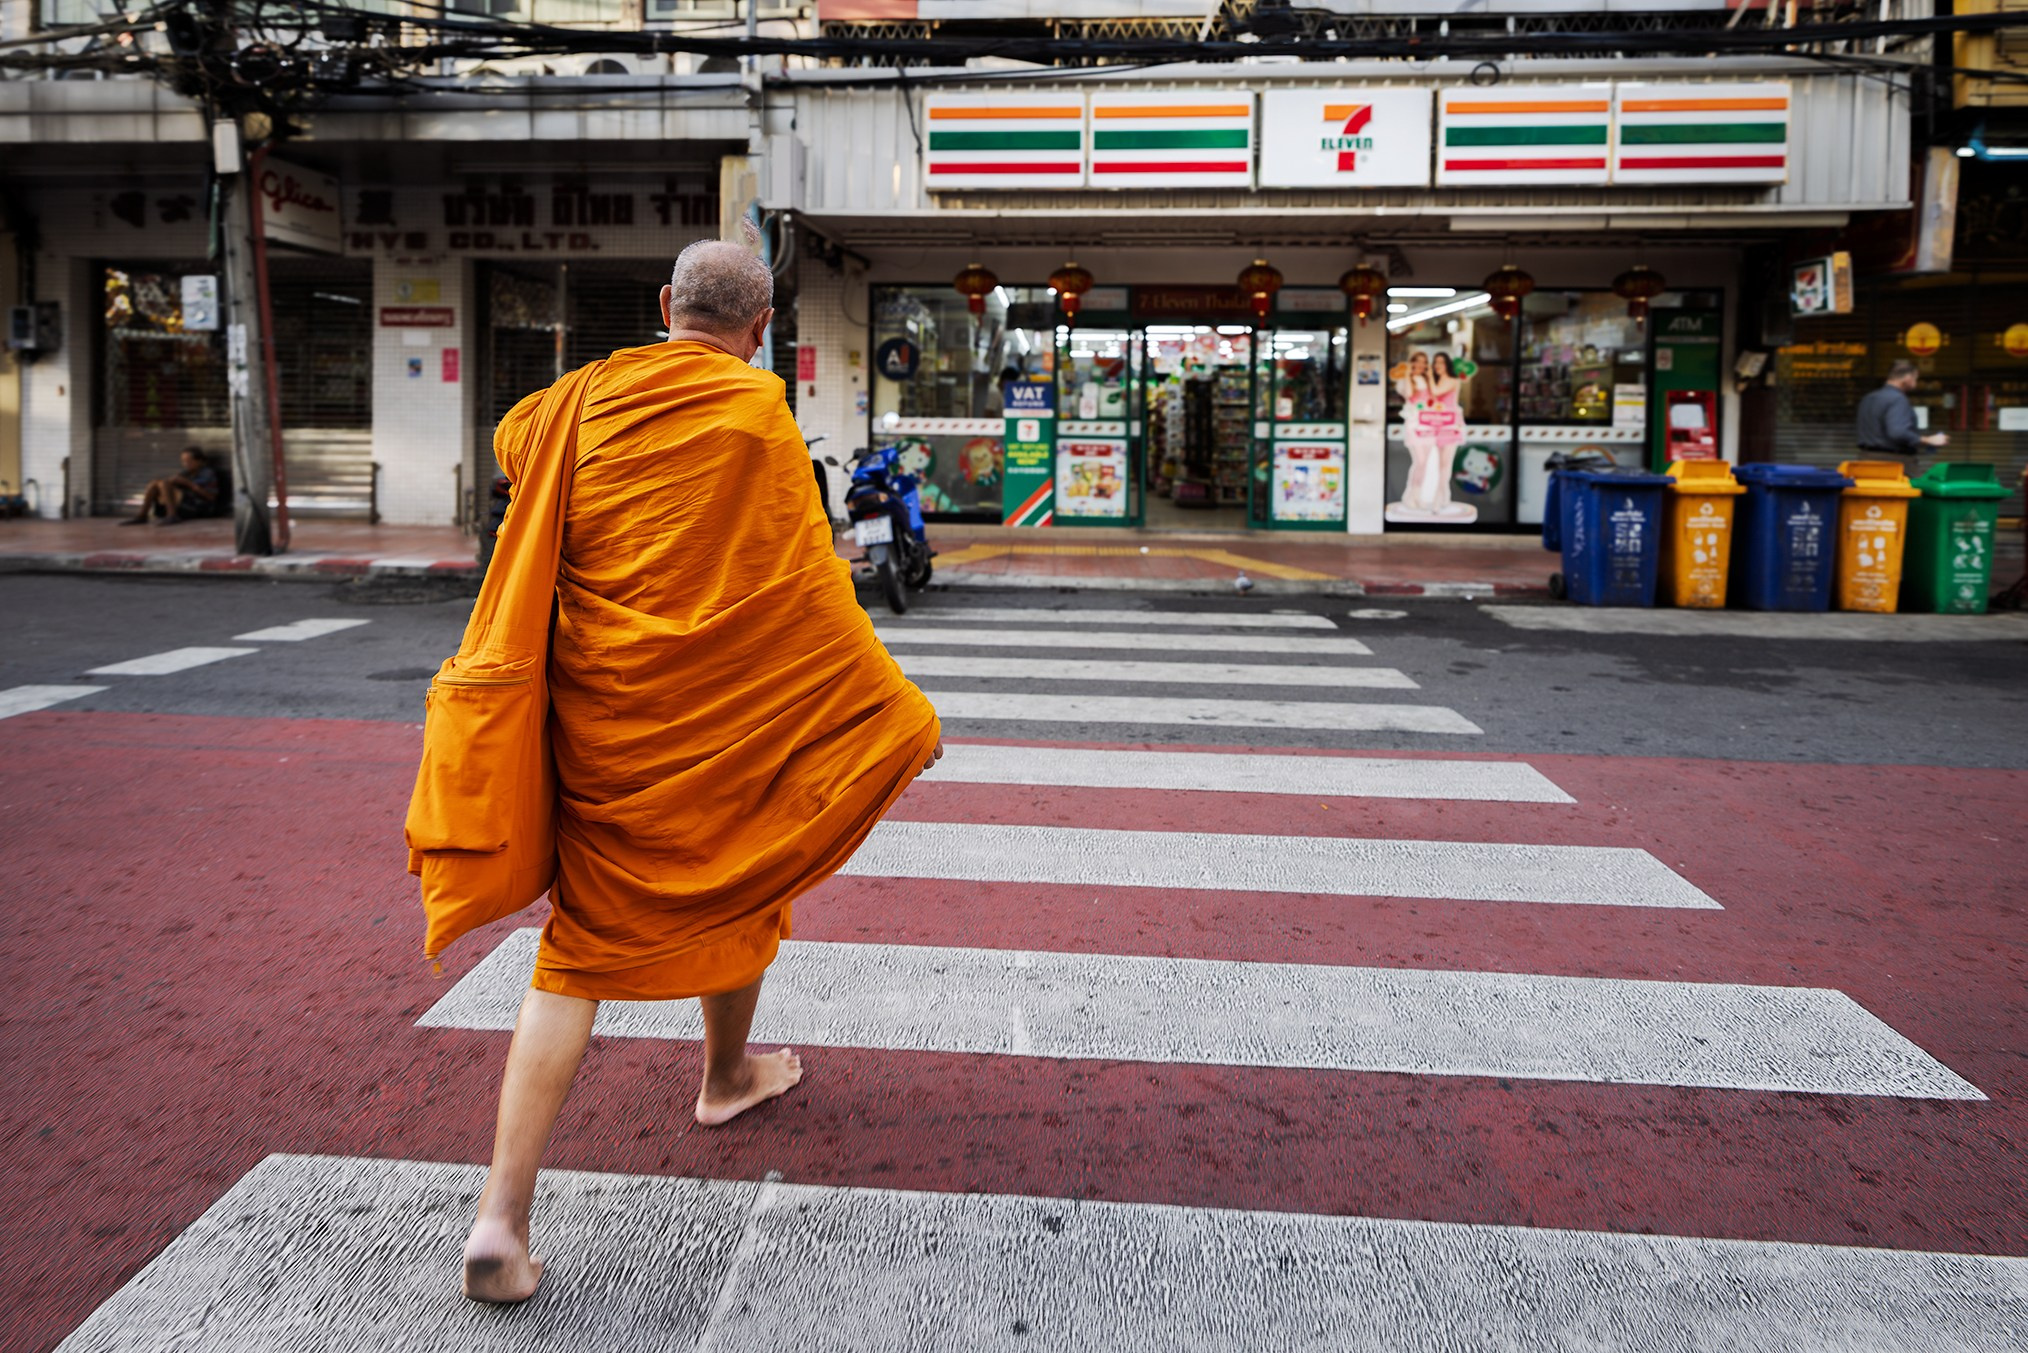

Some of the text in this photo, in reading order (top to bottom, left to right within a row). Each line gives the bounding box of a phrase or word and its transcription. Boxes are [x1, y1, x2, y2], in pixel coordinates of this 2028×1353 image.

[260, 169, 335, 212] Glico
[1667, 317, 1703, 331] ATM
[1012, 386, 1045, 401] VAT
